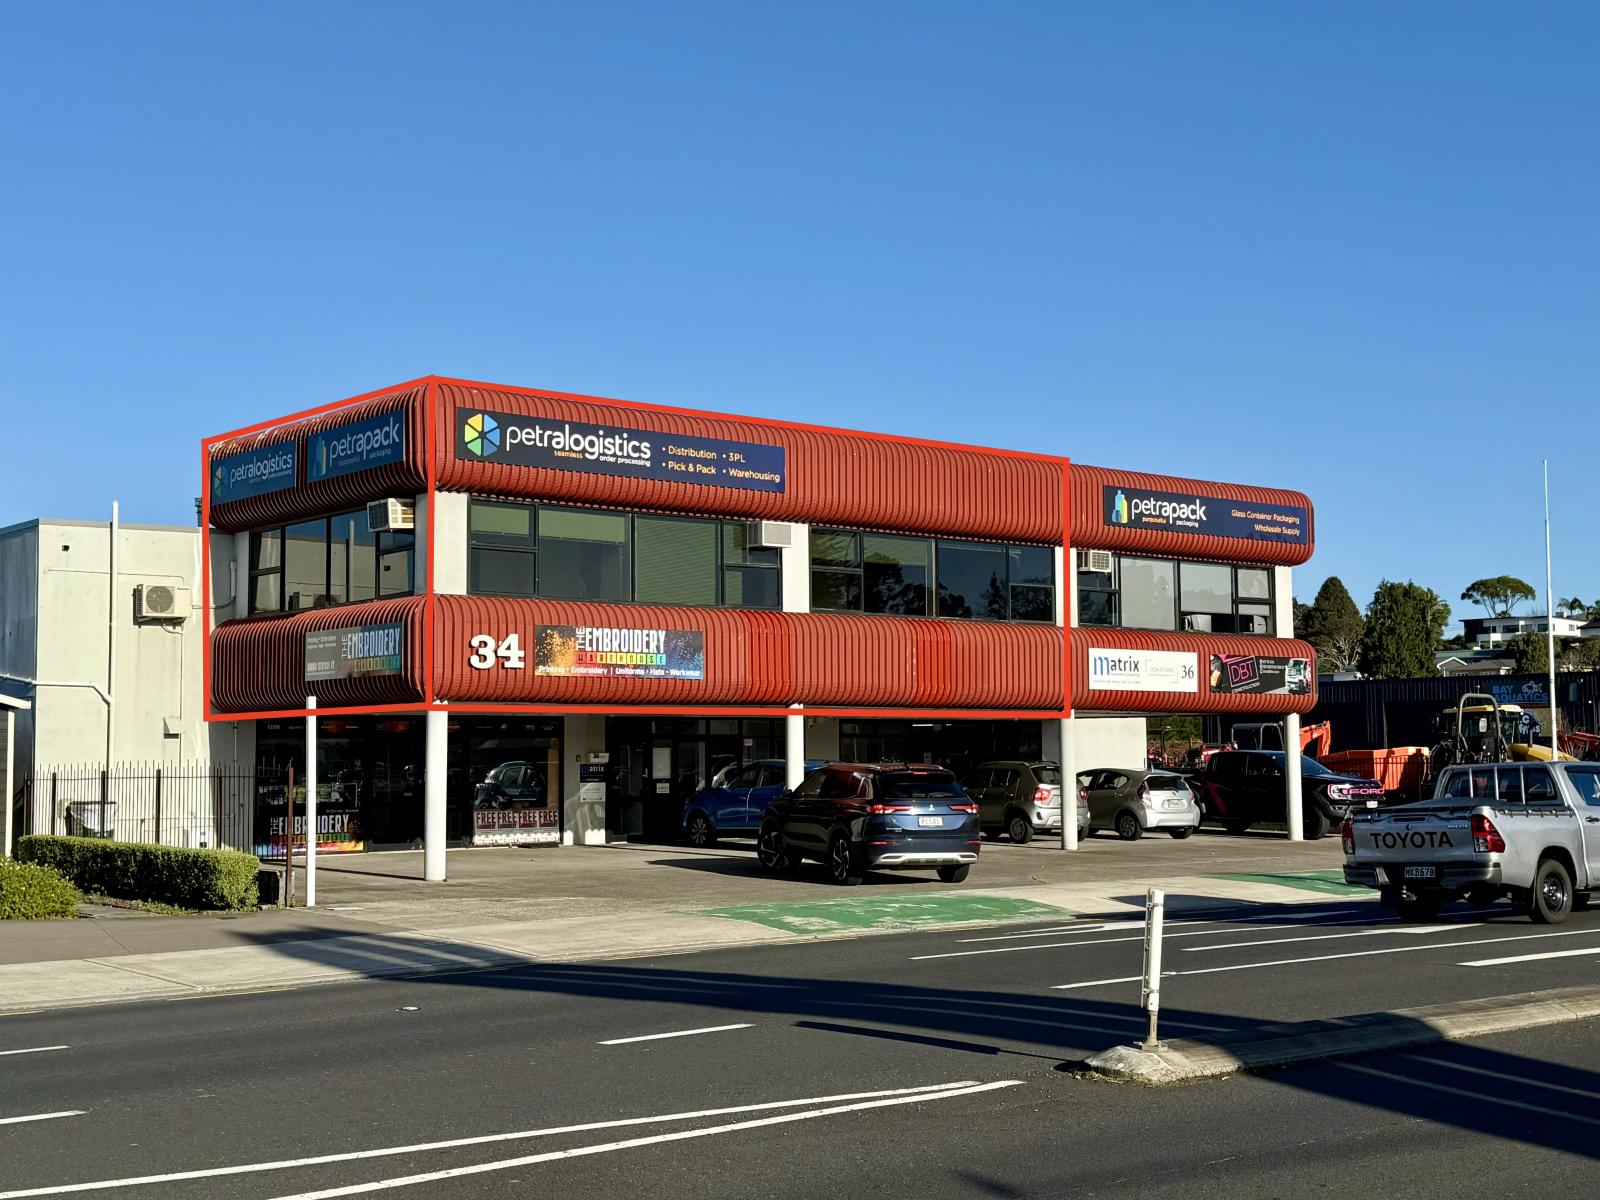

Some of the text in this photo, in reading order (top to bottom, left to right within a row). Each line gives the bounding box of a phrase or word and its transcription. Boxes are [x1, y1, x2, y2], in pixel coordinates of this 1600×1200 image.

[329, 416, 400, 468] petrapack
[506, 424, 651, 460] petralogistics
[553, 450, 583, 459] seamless
[599, 455, 651, 467] order processing
[668, 445, 746, 463] Distribution 3PL
[230, 451, 292, 488] petralogistics
[668, 461, 781, 482] Pick & Pack Warehousing
[1131, 497, 1207, 524] petrapack
[1231, 509, 1300, 525] Glass Container Packaging
[1254, 523, 1301, 537] Wholesale Supply
[347, 627, 400, 659] EMBROIDERY
[575, 626, 585, 650] THE
[585, 627, 666, 654] EMBROIDERY
[468, 633, 525, 670] 34
[577, 651, 665, 664] WAREHOUSE
[538, 665, 701, 676] Printing Embroidery Uniforms Hats Workwear
[1181, 665, 1194, 679] 36
[1231, 660, 1254, 682] DBT
[1493, 685, 1513, 694] BAY
[1494, 693, 1549, 703] AQUATICS
[278, 814, 349, 836] EBRIDERY
[476, 810, 558, 825] FREE FREE FREE FREE
[1369, 831, 1454, 849] TOYOTA
